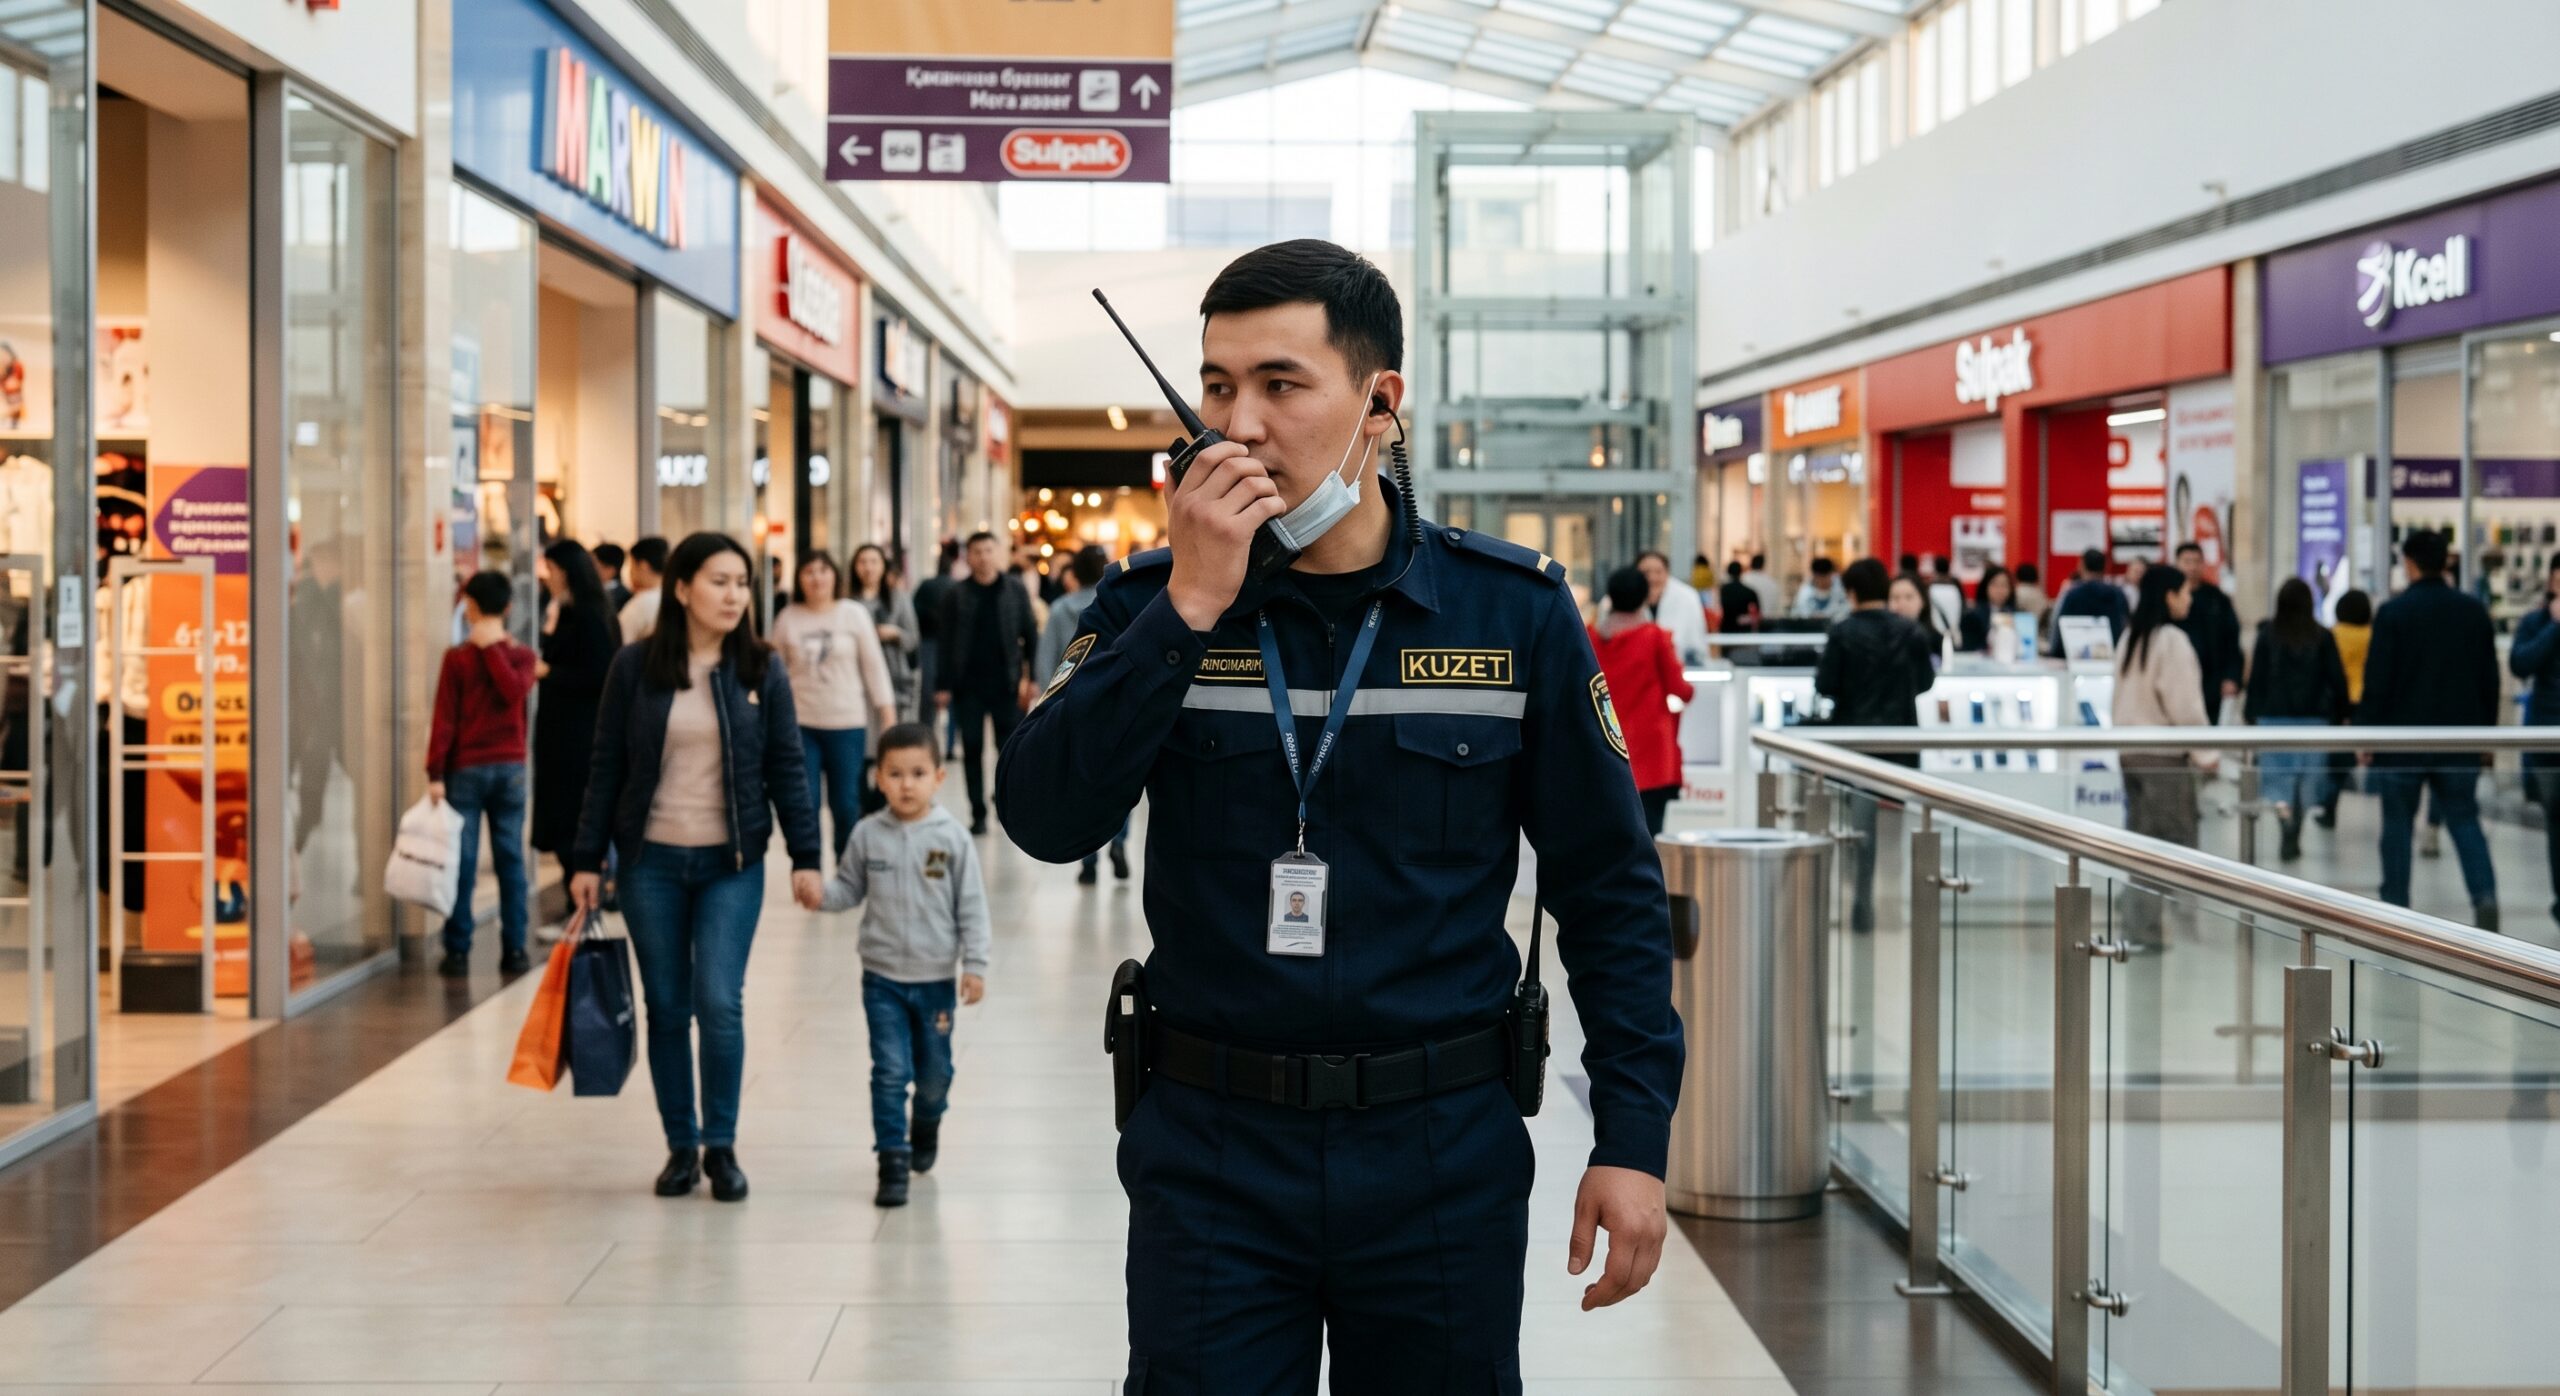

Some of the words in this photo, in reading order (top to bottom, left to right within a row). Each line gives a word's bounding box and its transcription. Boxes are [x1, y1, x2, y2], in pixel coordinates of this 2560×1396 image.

[552, 47, 687, 252] MARWIN
[1013, 136, 1119, 170] Sulpak
[2393, 234, 2467, 309] Kcell
[1955, 326, 2033, 413] Sulpak
[1409, 655, 1506, 679] KUZET
